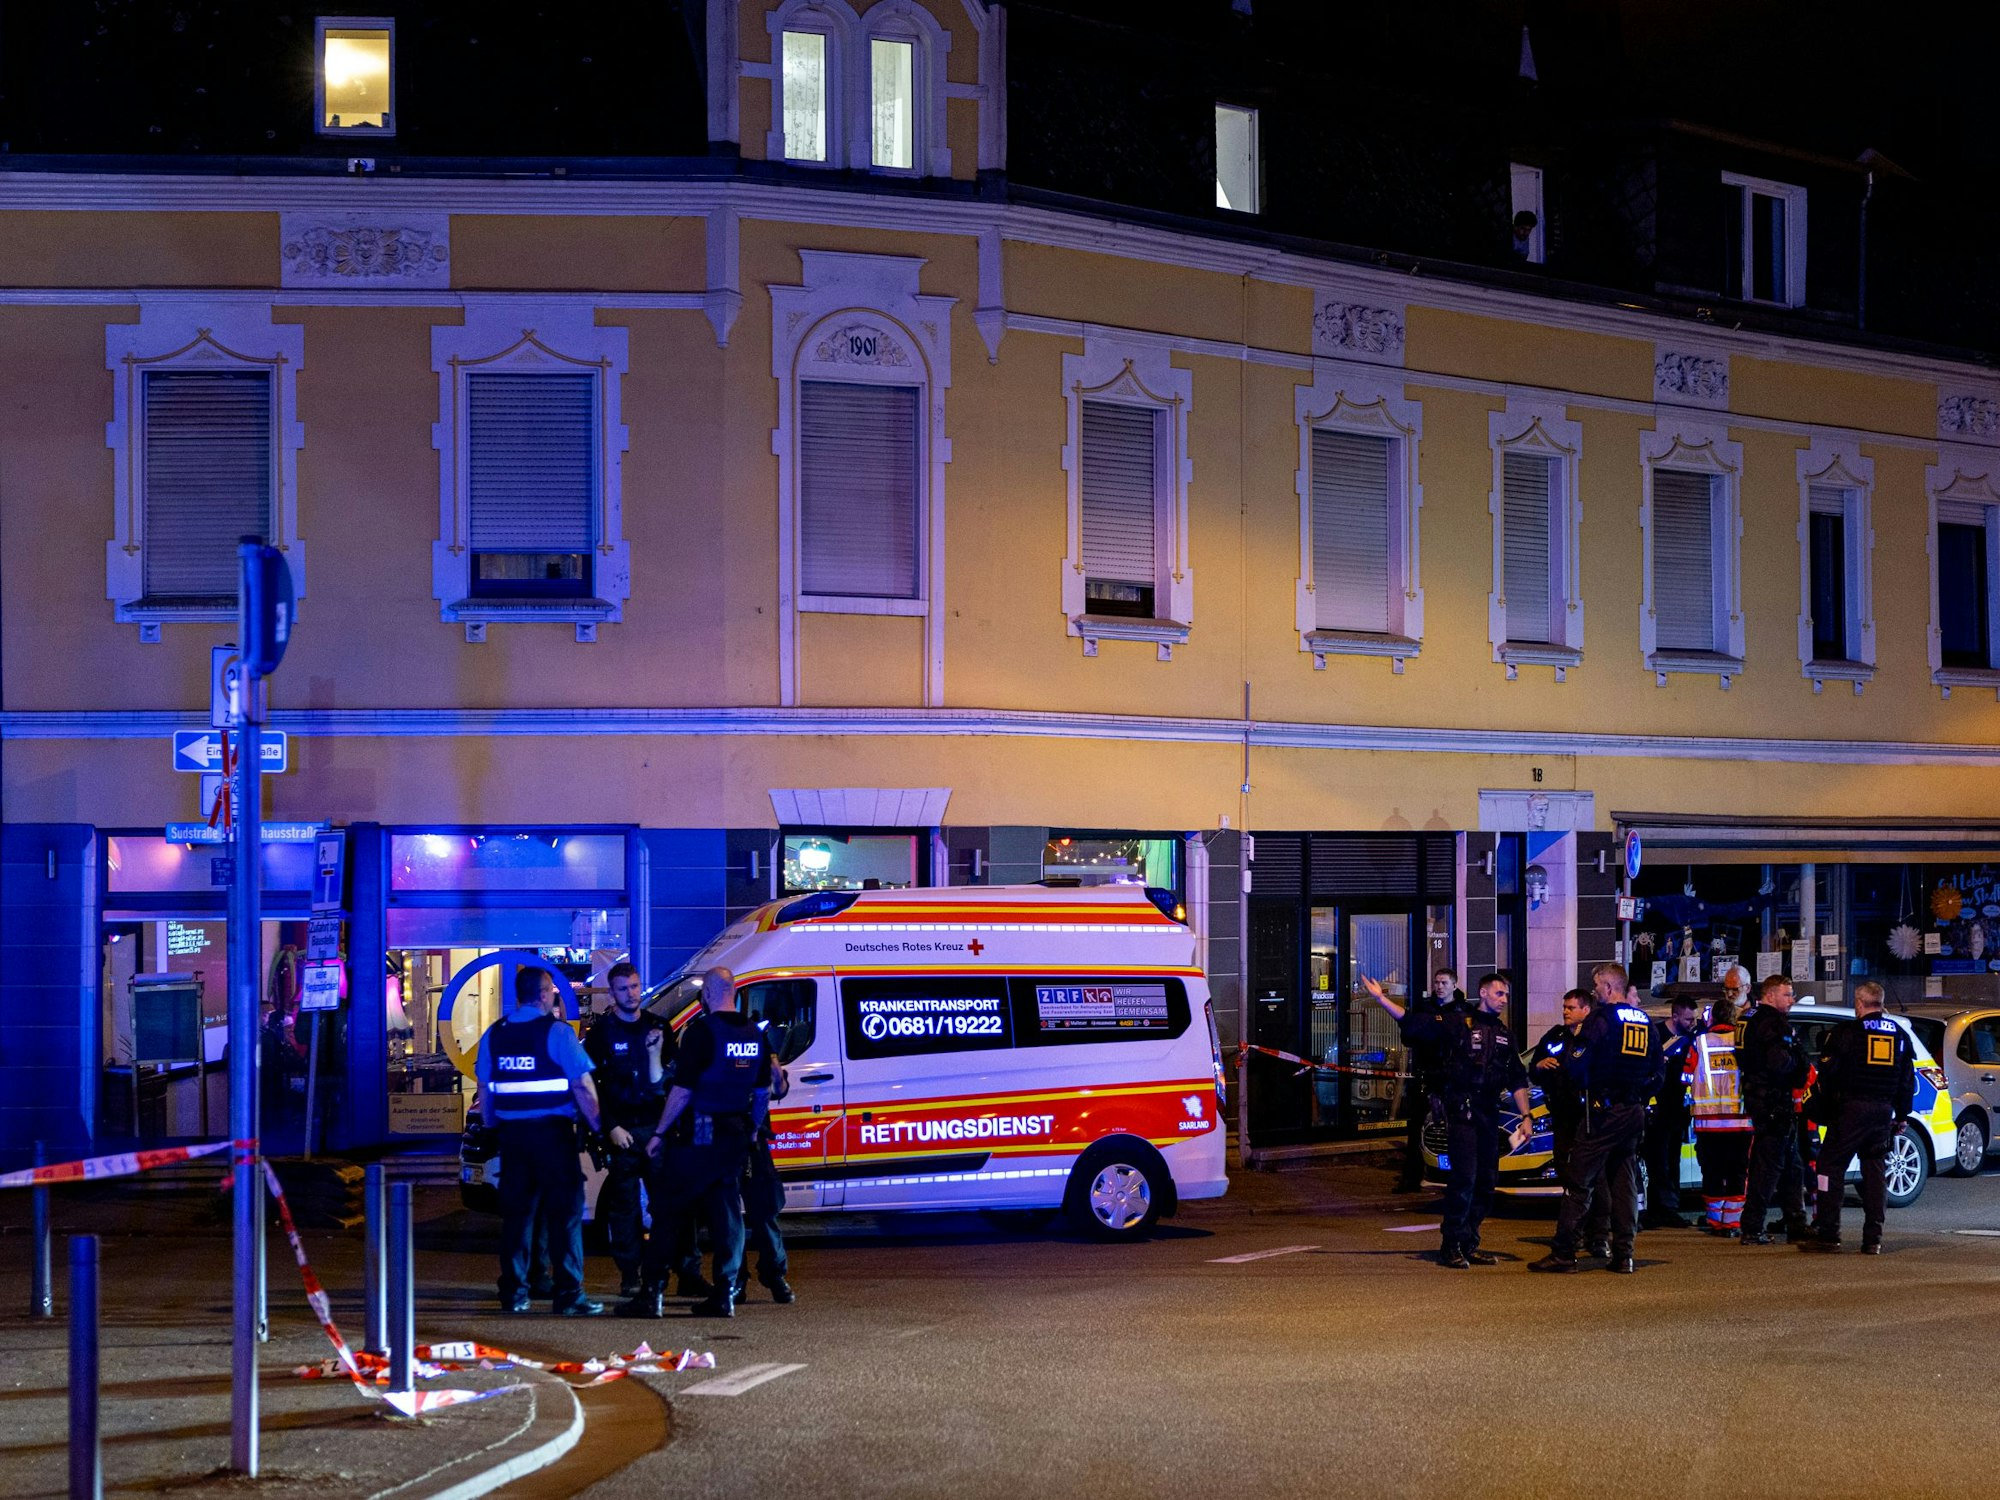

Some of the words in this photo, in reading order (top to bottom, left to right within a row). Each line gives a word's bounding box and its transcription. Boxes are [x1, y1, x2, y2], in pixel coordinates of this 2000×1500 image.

[850, 336, 876, 356] 1901
[1532, 767, 1543, 782] 18
[845, 943, 899, 952] Deutsches
[902, 942, 932, 951] Rotes
[934, 942, 964, 951] Kreuz
[1433, 939, 1443, 949] 18
[860, 999, 1000, 1013] KRANKENTRANSPORT
[1118, 1007, 1166, 1016] GEMEINSAM
[888, 1015, 1002, 1036] 0681/19222
[1863, 1019, 1897, 1032] POLIZEI
[726, 1042, 759, 1057] POLIZEI
[498, 1056, 535, 1071] POLIZEI
[861, 1115, 1054, 1144] RETTUNGSDIENST
[1178, 1120, 1209, 1130] SAARLAND
[786, 1130, 820, 1140] Saarland
[777, 1140, 812, 1150] Sulzbach
